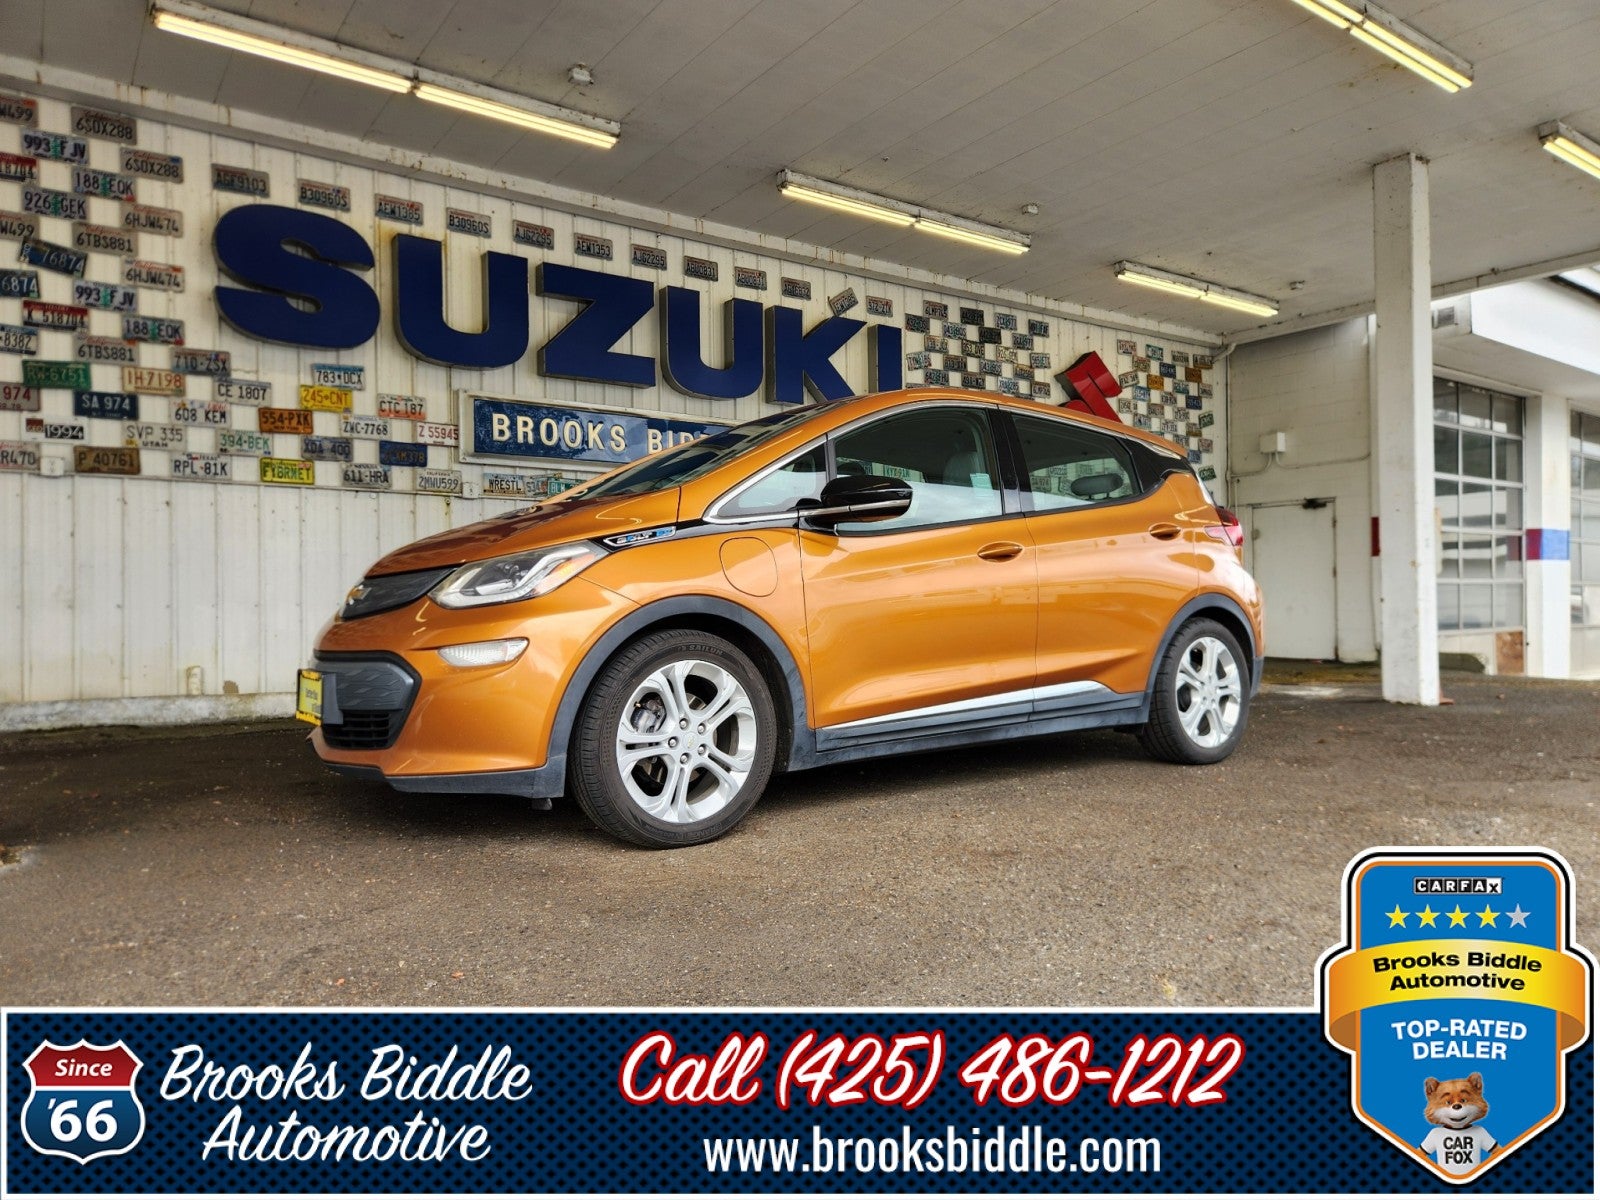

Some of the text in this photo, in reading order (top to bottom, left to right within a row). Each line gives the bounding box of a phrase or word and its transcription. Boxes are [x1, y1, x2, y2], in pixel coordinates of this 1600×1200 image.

[24, 134, 51, 153] 993
[76, 171, 100, 190] 188
[24, 190, 86, 216] 926 GEK
[124, 212, 180, 233] 6HJW474
[449, 214, 489, 234] B30960S
[76, 232, 133, 252] 6TBS881
[125, 268, 180, 288] 6HJW474
[76, 285, 100, 303] 993
[213, 203, 902, 406] SUZUKI
[126, 319, 149, 336] 188
[78, 344, 134, 362] 6TBS881
[316, 371, 336, 384] 783
[3, 386, 31, 402] 974
[218, 383, 267, 401] CE 1807
[82, 393, 130, 411] SA 974
[379, 399, 423, 416] CTC 187
[175, 408, 198, 422] 608
[45, 424, 83, 439] 1994
[127, 425, 183, 442] SVP 335
[428, 426, 459, 441] 55945
[491, 412, 627, 453] BROOKS
[93, 452, 134, 467] 40761
[174, 460, 228, 477] RPL 81K
[488, 478, 521, 492] WRESTL
